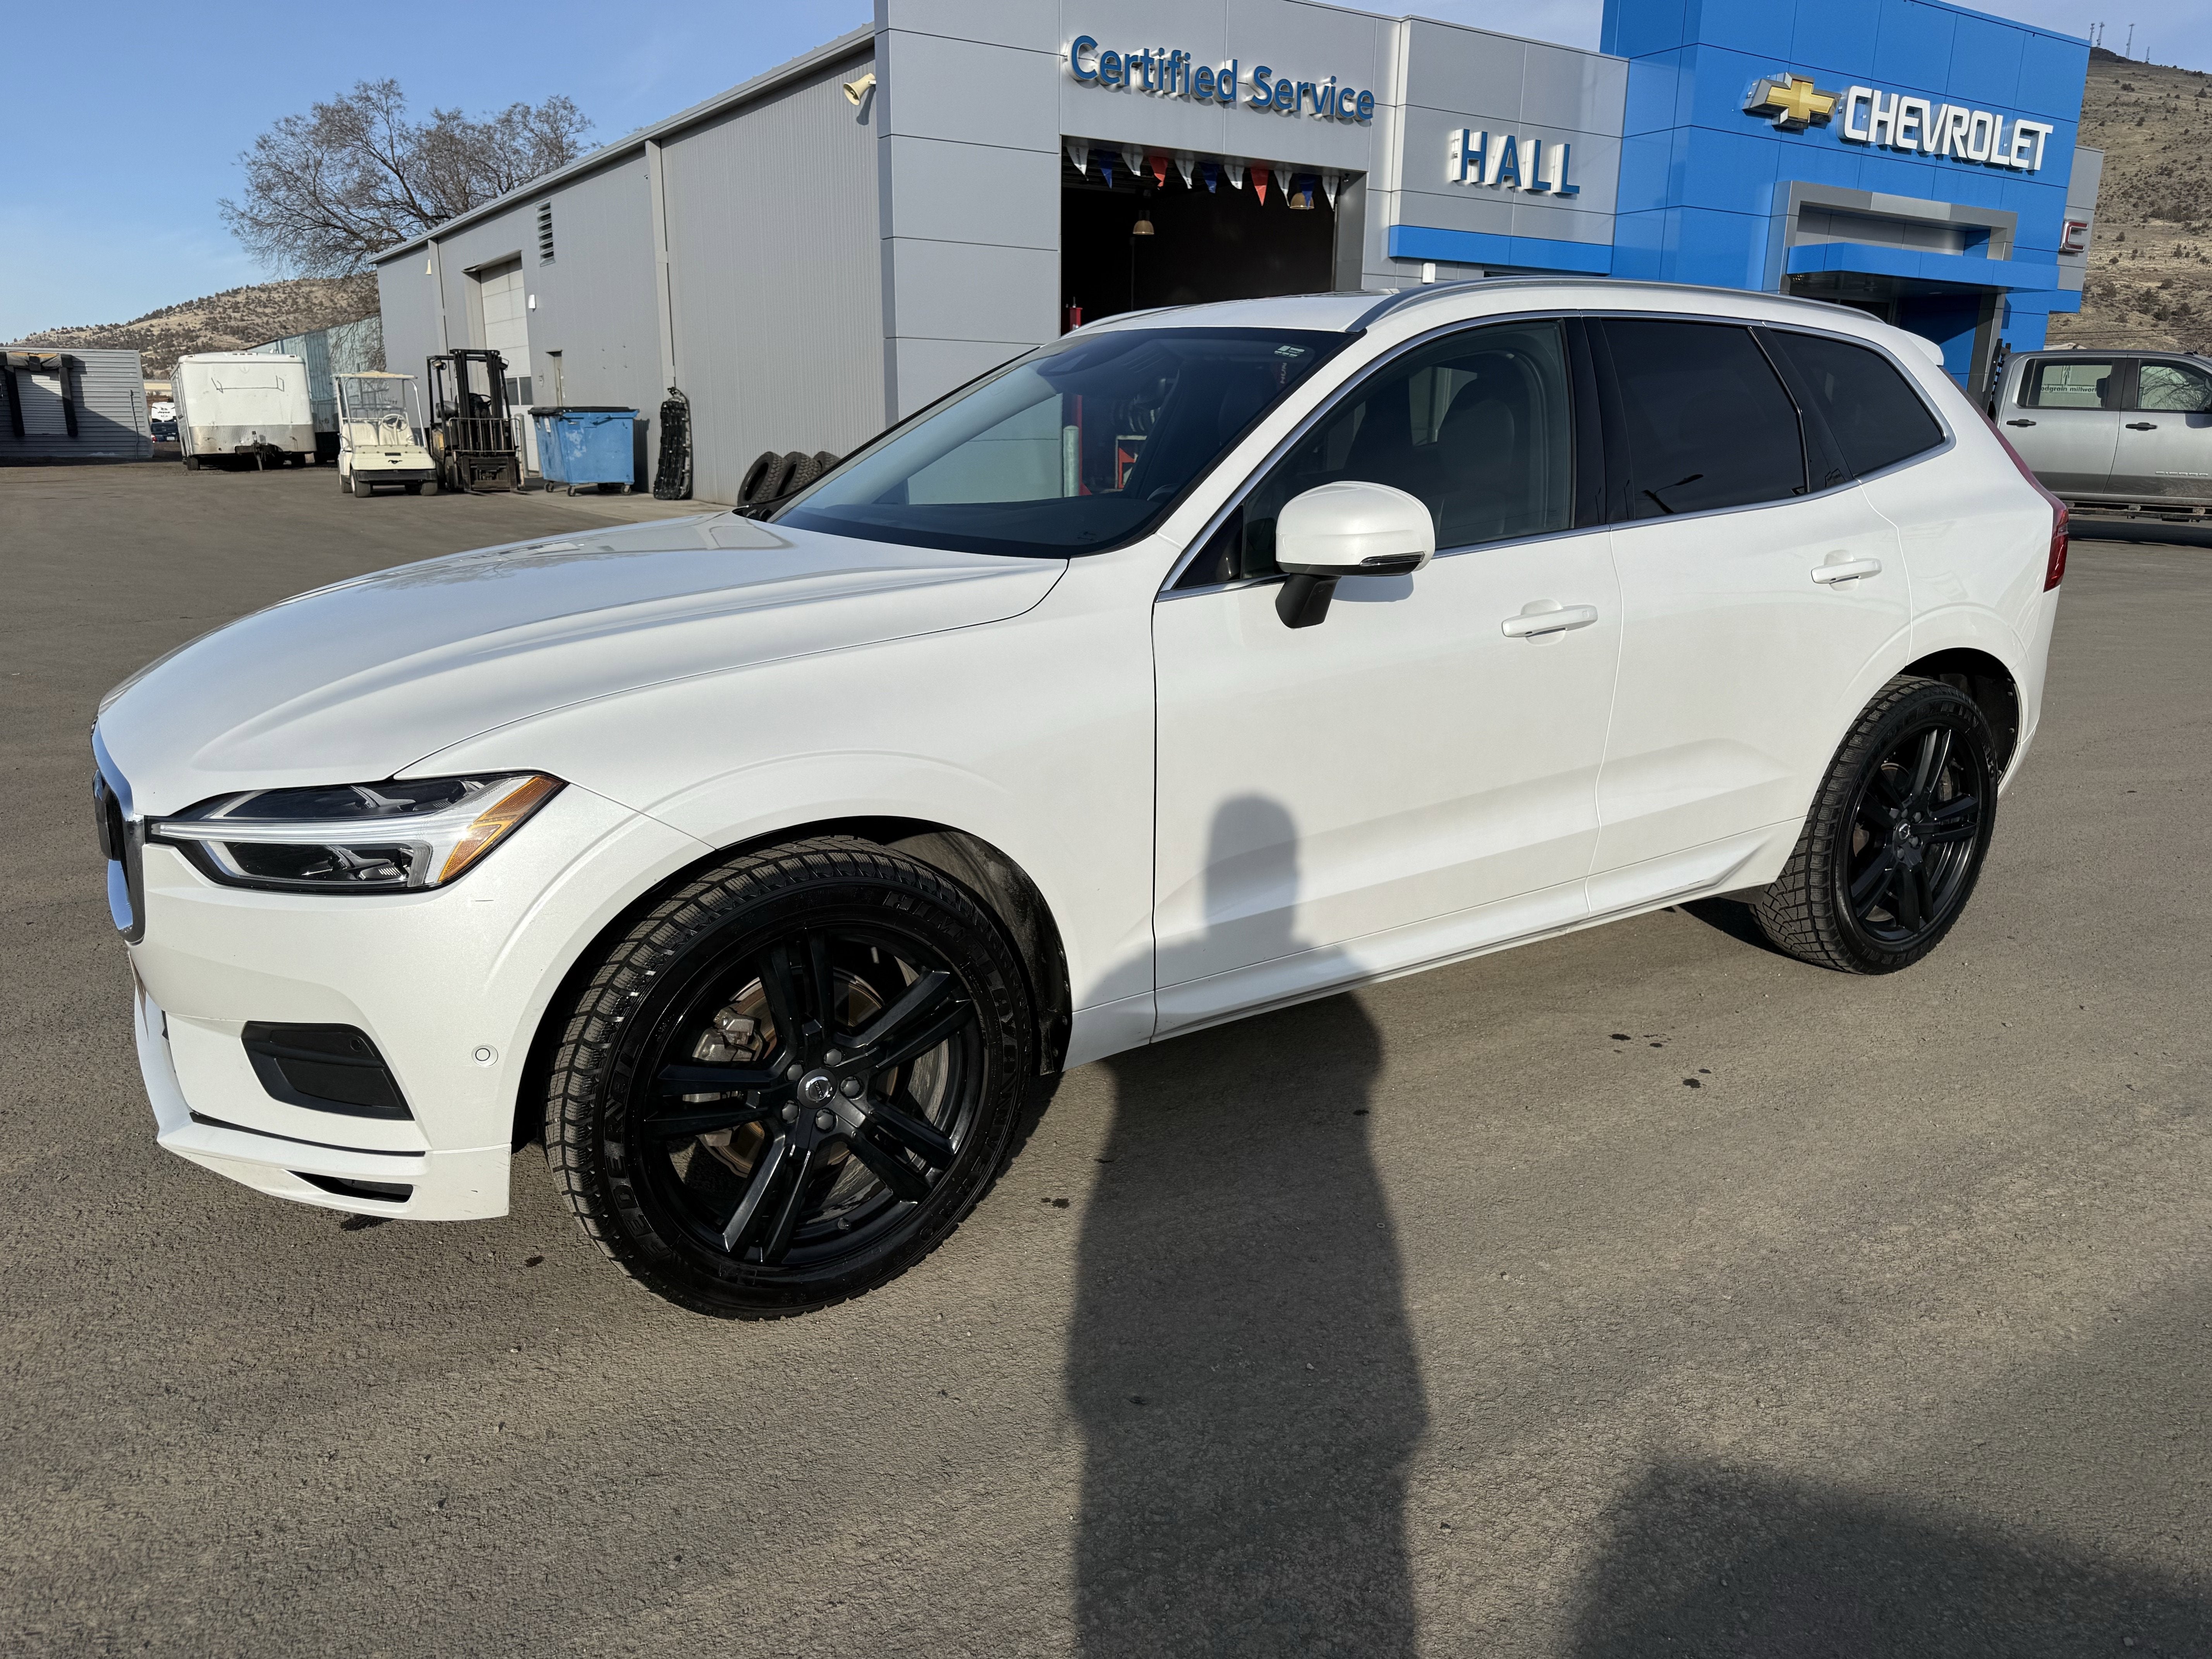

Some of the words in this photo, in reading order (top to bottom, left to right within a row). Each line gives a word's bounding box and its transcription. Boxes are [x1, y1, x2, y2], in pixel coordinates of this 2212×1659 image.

[1071, 35, 1238, 101] Certified
[1251, 65, 1375, 120] Service
[1460, 128, 1580, 194] HALL
[1844, 85, 2054, 171] CHEVROLET
[2060, 221, 2088, 251] C
[605, 1043, 673, 1262] FEDERAL
